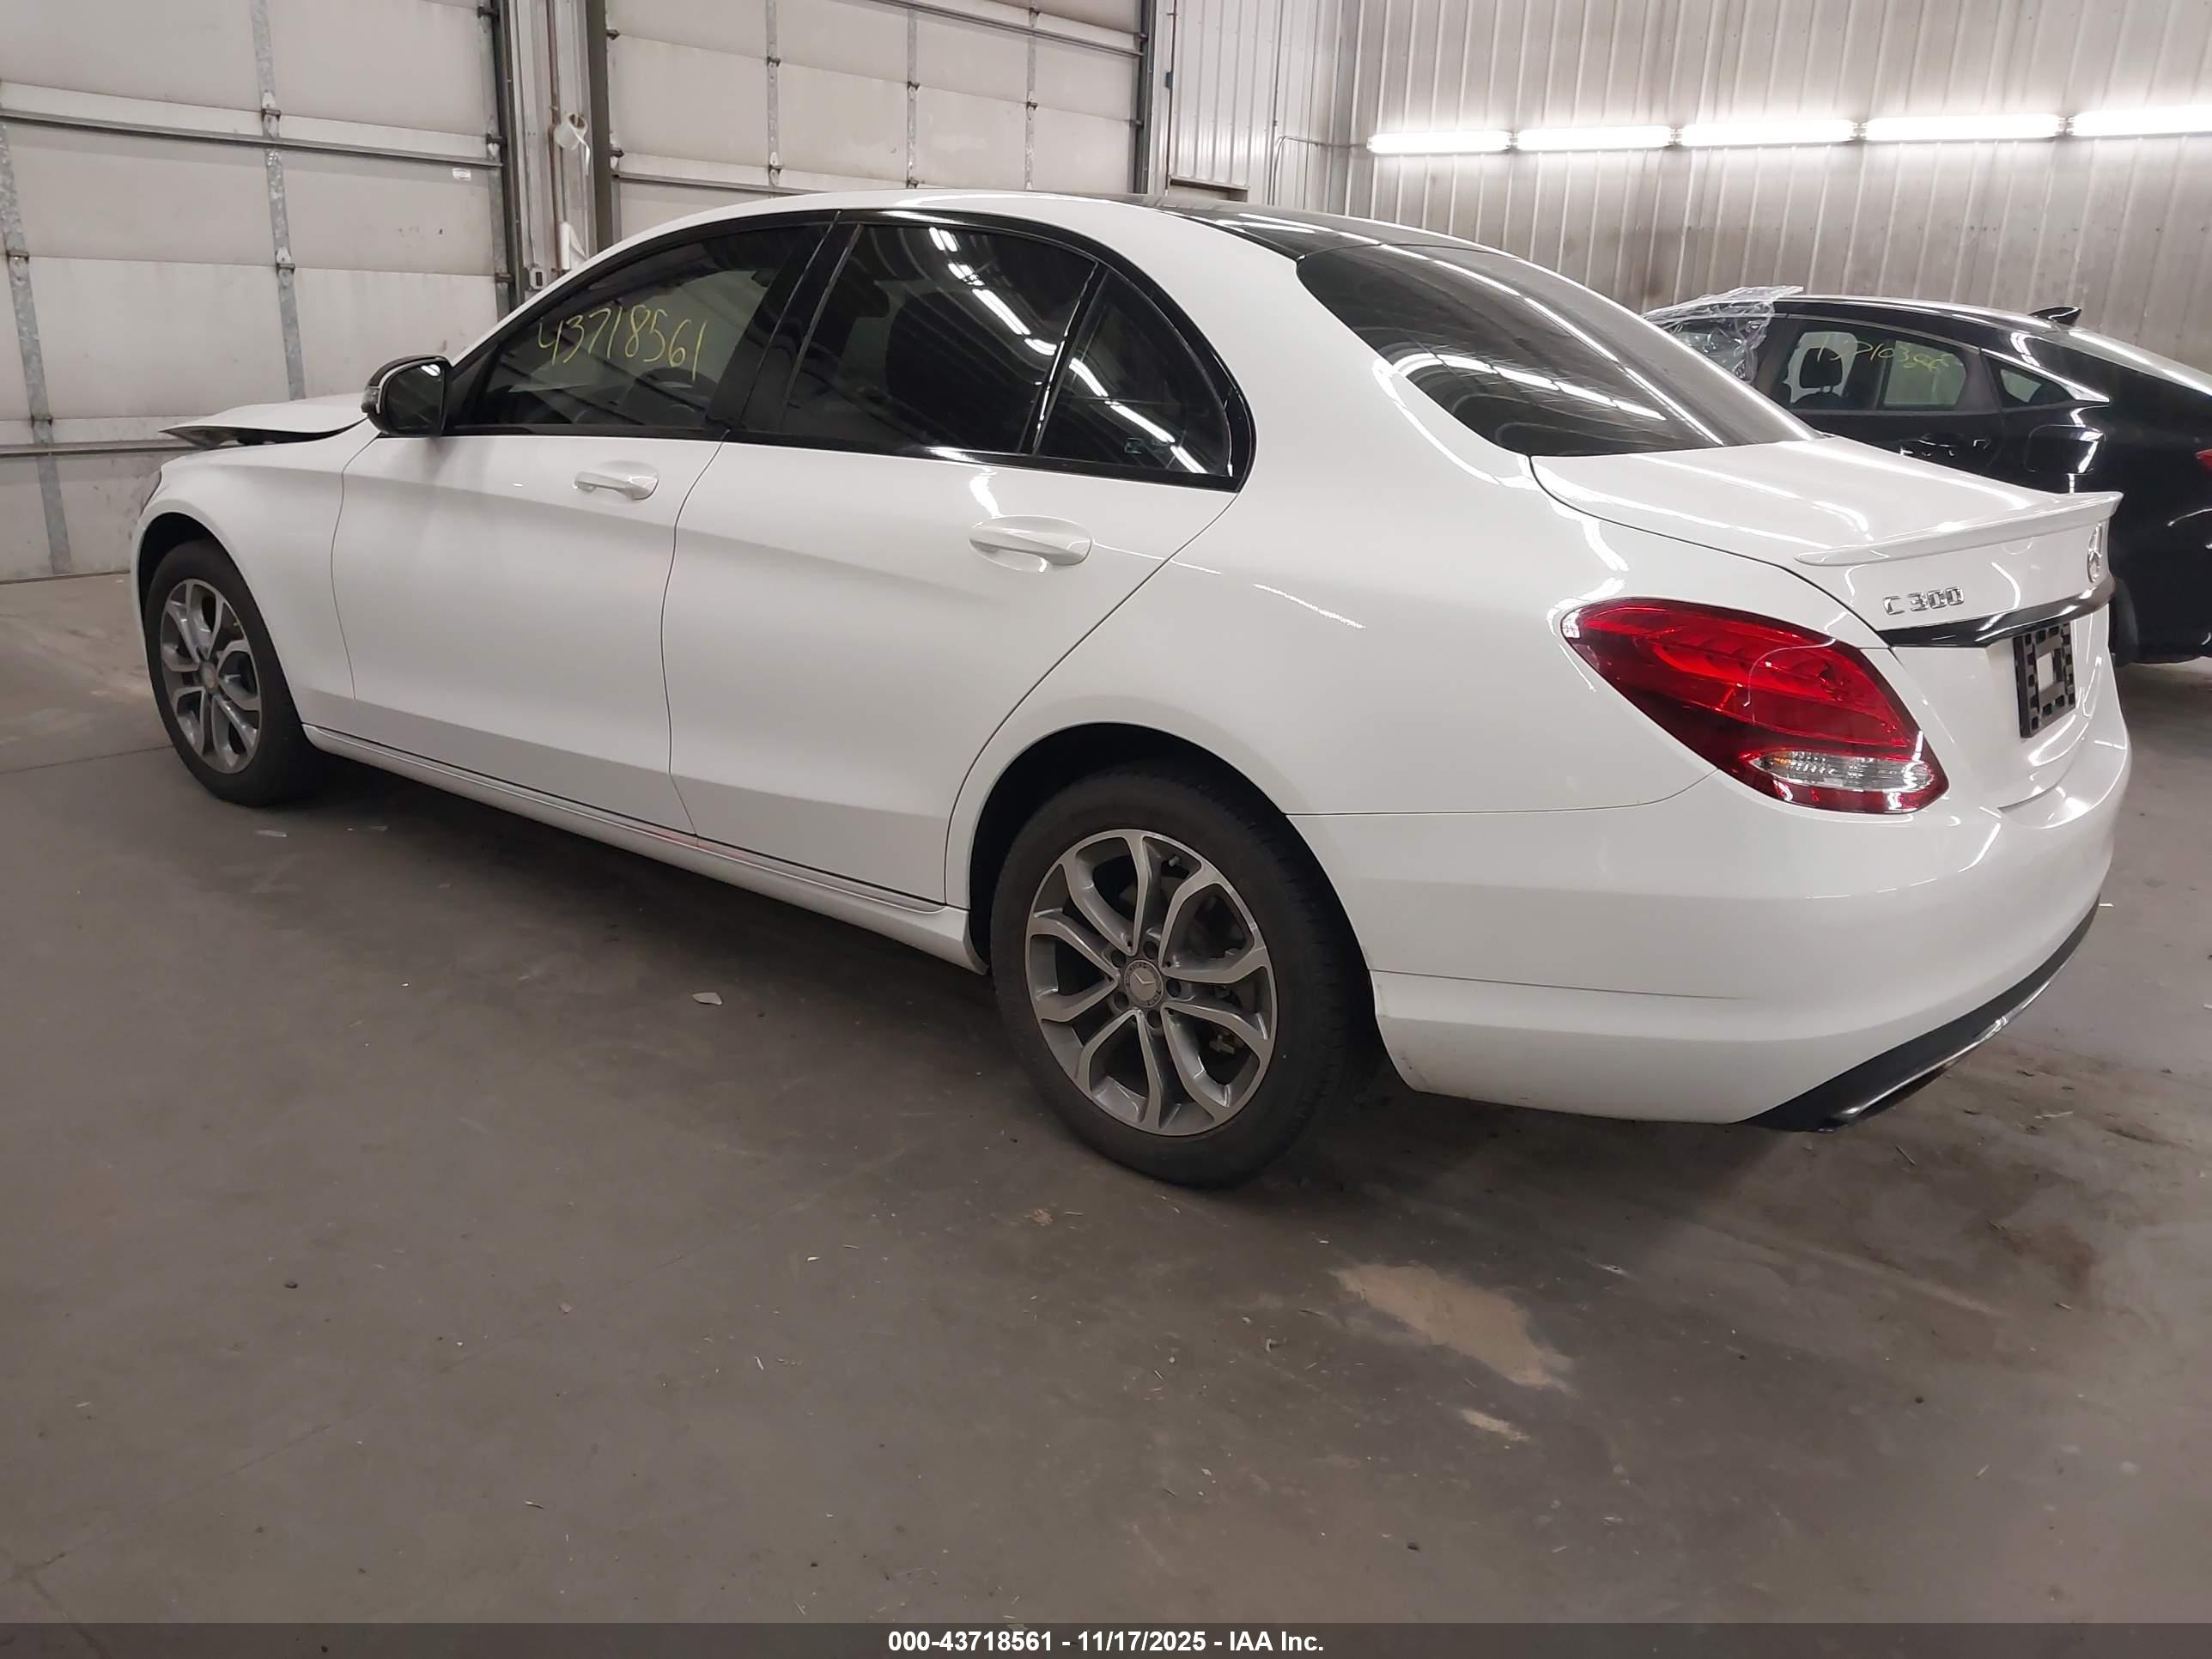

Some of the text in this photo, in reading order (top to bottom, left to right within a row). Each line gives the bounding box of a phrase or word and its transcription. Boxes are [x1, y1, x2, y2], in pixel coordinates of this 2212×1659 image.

[538, 303, 709, 381] 43718561
[1881, 586, 1966, 616] C 300
